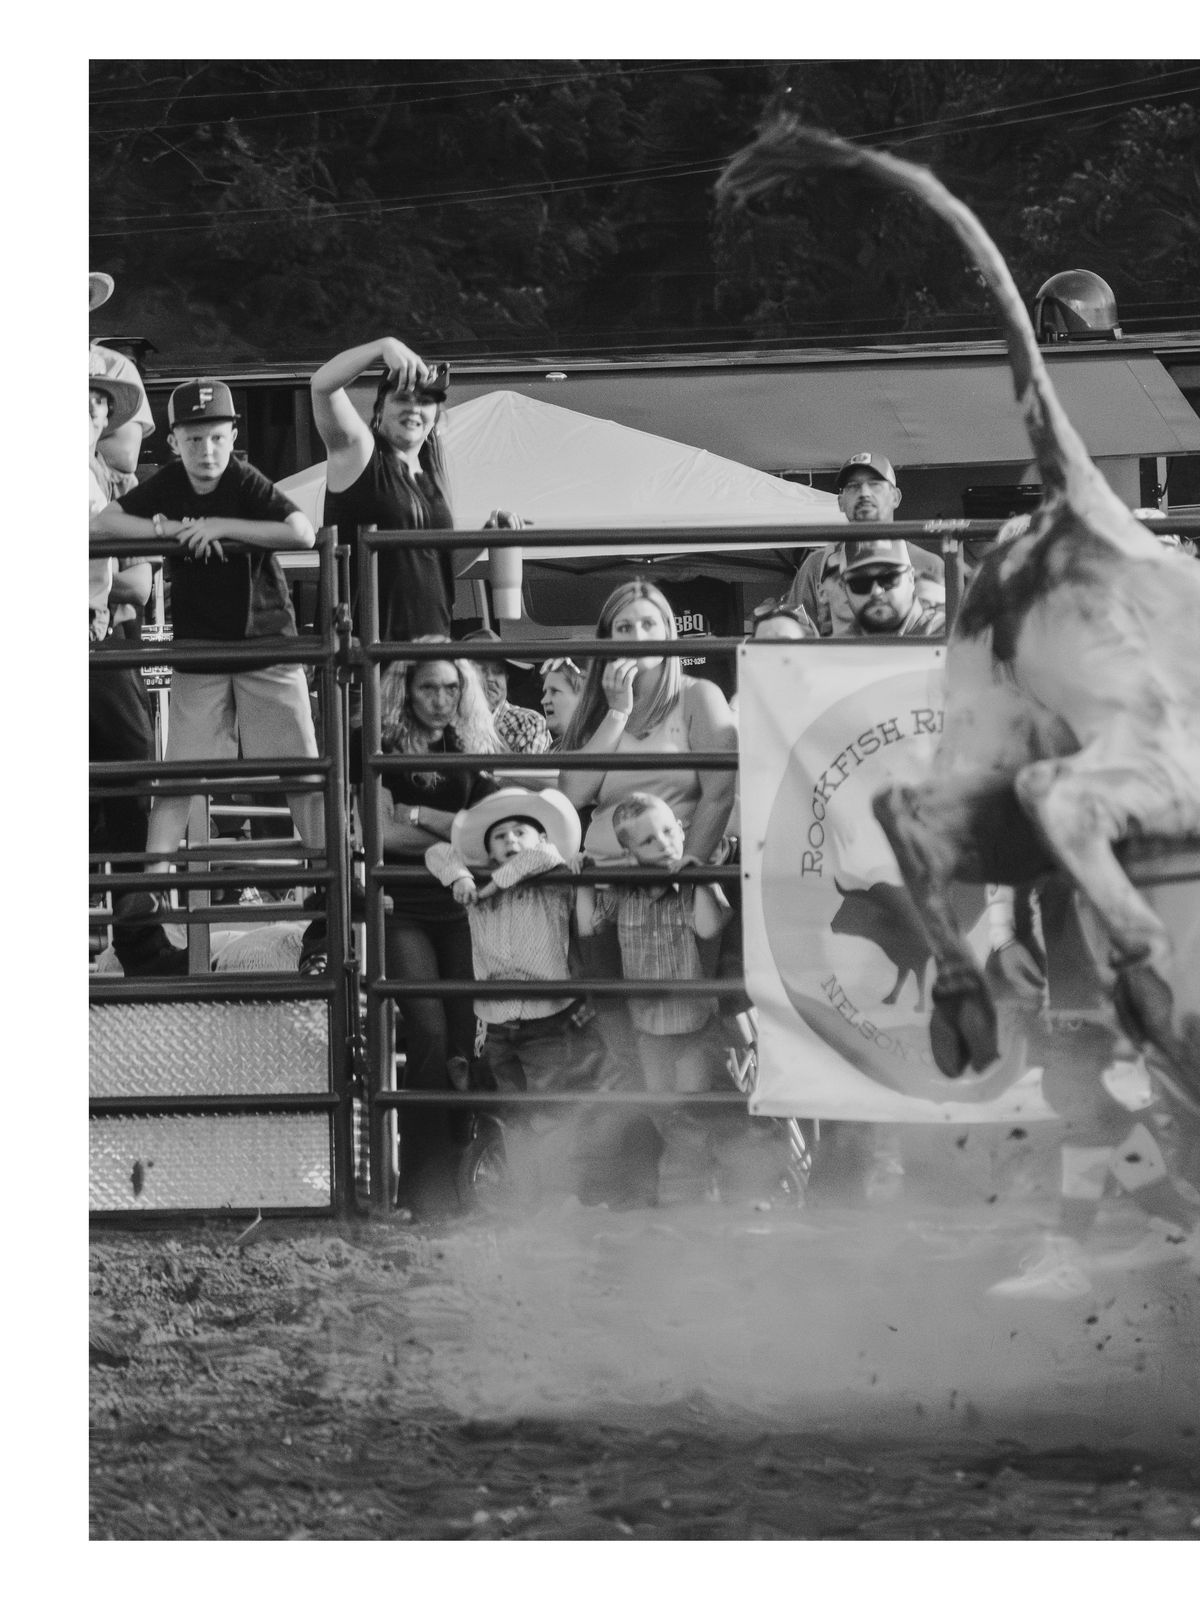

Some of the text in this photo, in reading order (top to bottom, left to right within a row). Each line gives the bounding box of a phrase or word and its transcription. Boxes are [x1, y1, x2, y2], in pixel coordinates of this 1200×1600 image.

[674, 613, 704, 633] BBQ
[802, 717, 905, 878] ROCKFISH
[821, 974, 907, 1061] NELSON
